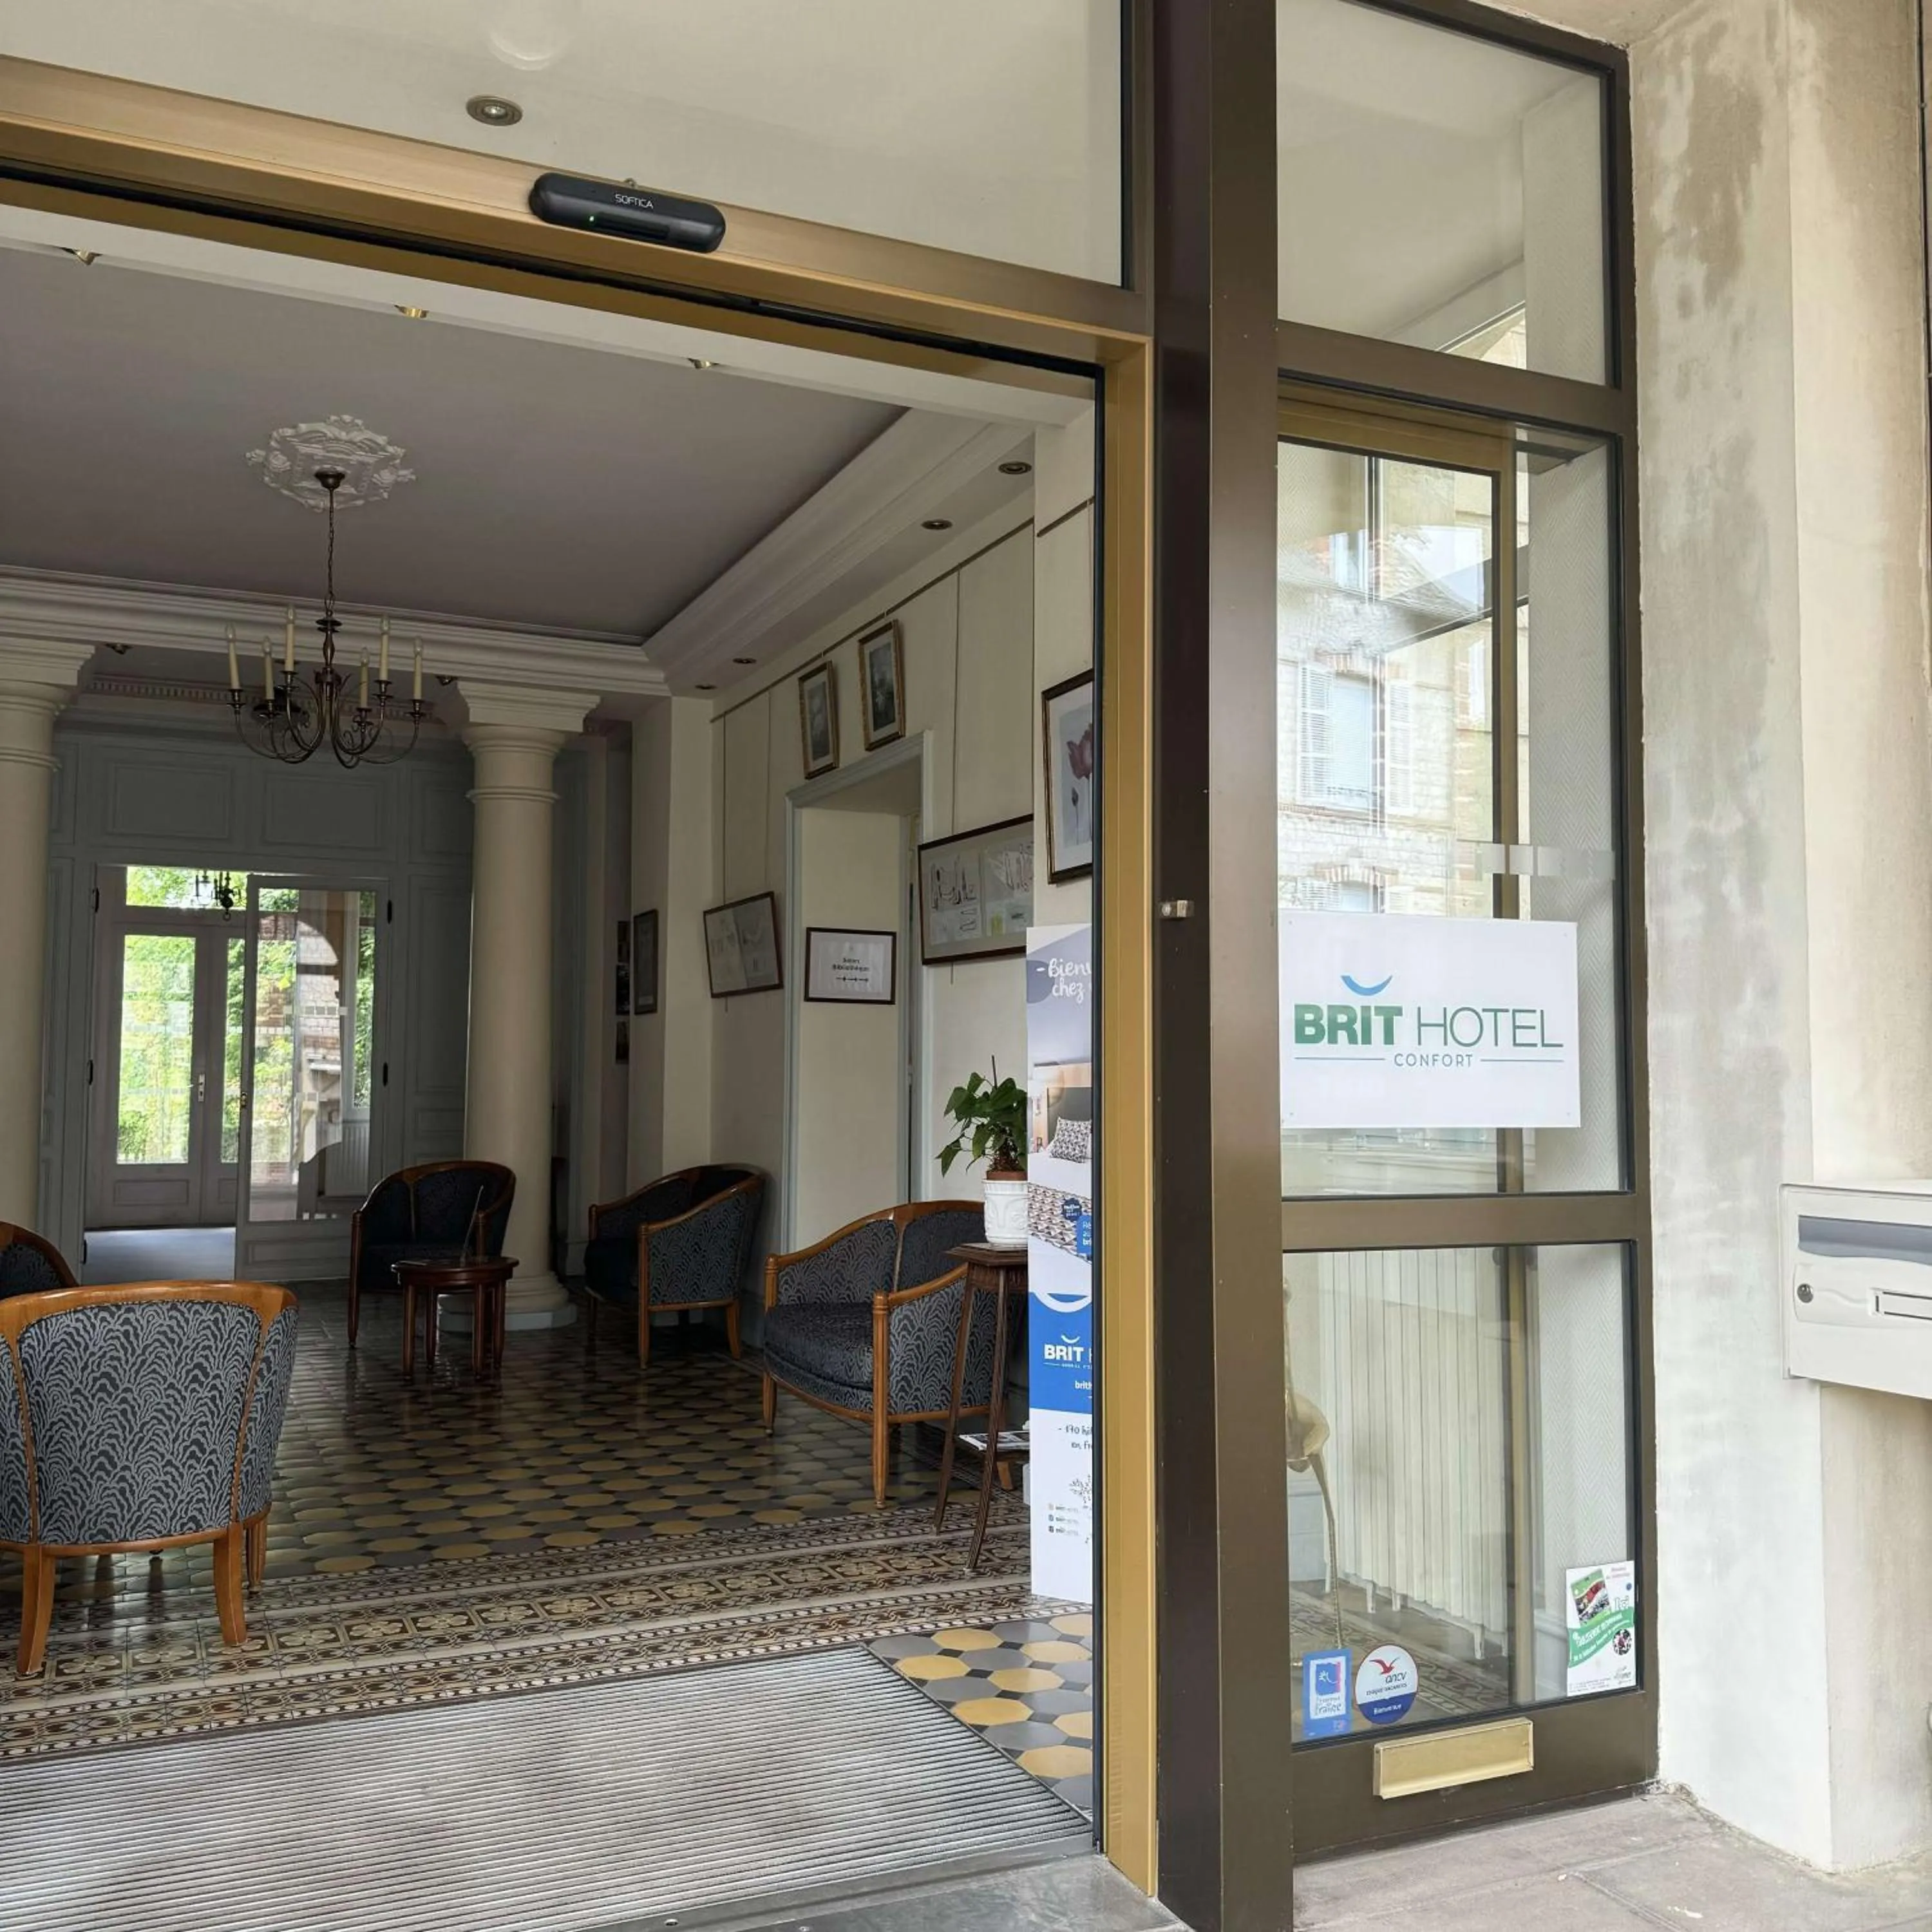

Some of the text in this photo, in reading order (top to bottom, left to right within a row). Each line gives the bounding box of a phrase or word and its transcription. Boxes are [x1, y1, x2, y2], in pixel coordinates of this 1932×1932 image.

[615, 194, 653, 209] SOFTICA
[1052, 978, 1084, 1004] chez
[1294, 1004, 1564, 1048] BRIT HOTEL
[1394, 1053, 1473, 1068] CONFORT
[1044, 1344, 1084, 1361] BRIT
